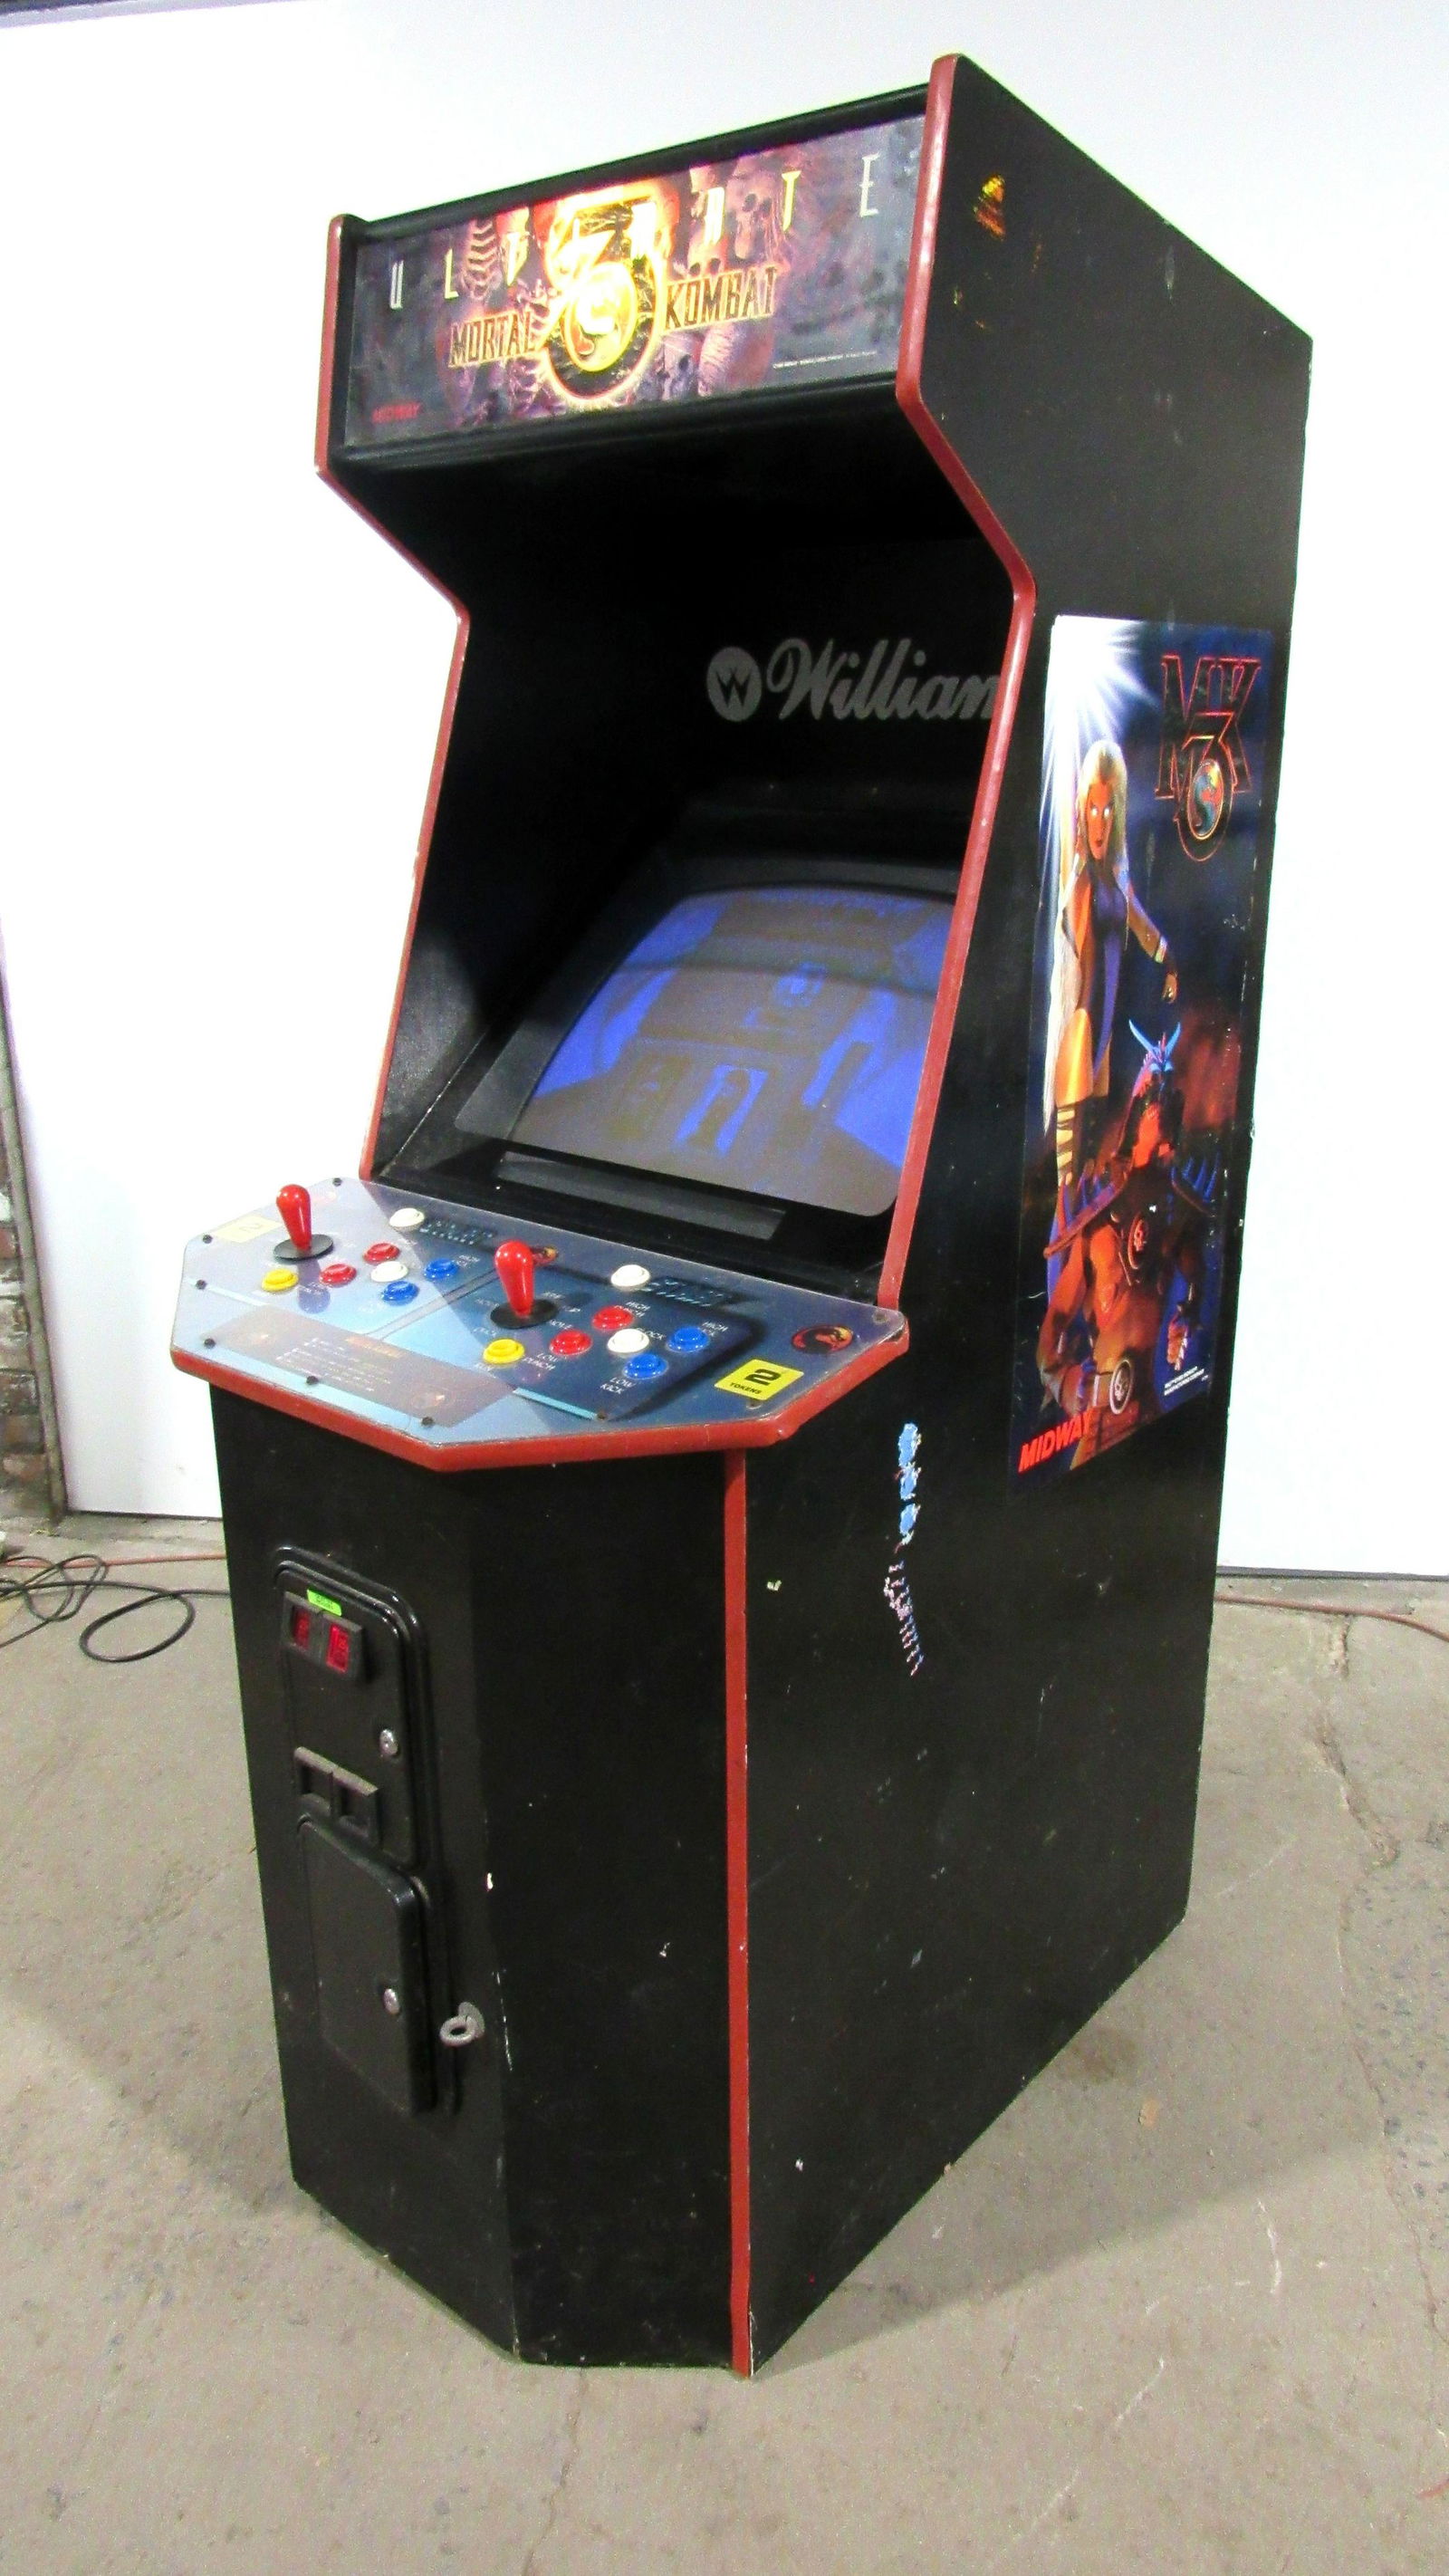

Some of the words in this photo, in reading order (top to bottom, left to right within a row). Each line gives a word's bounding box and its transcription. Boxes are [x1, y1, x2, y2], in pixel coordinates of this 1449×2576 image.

[447, 308, 536, 368] MORTAL
[665, 265, 780, 333] KOMBAT
[766, 638, 1002, 720] William
[609, 1377, 635, 1388] LOW
[744, 1369, 782, 1386] 2
[600, 1382, 624, 1395] KICK
[730, 1382, 763, 1395] TOKENS
[1017, 1408, 1098, 1475] MIDWAY
